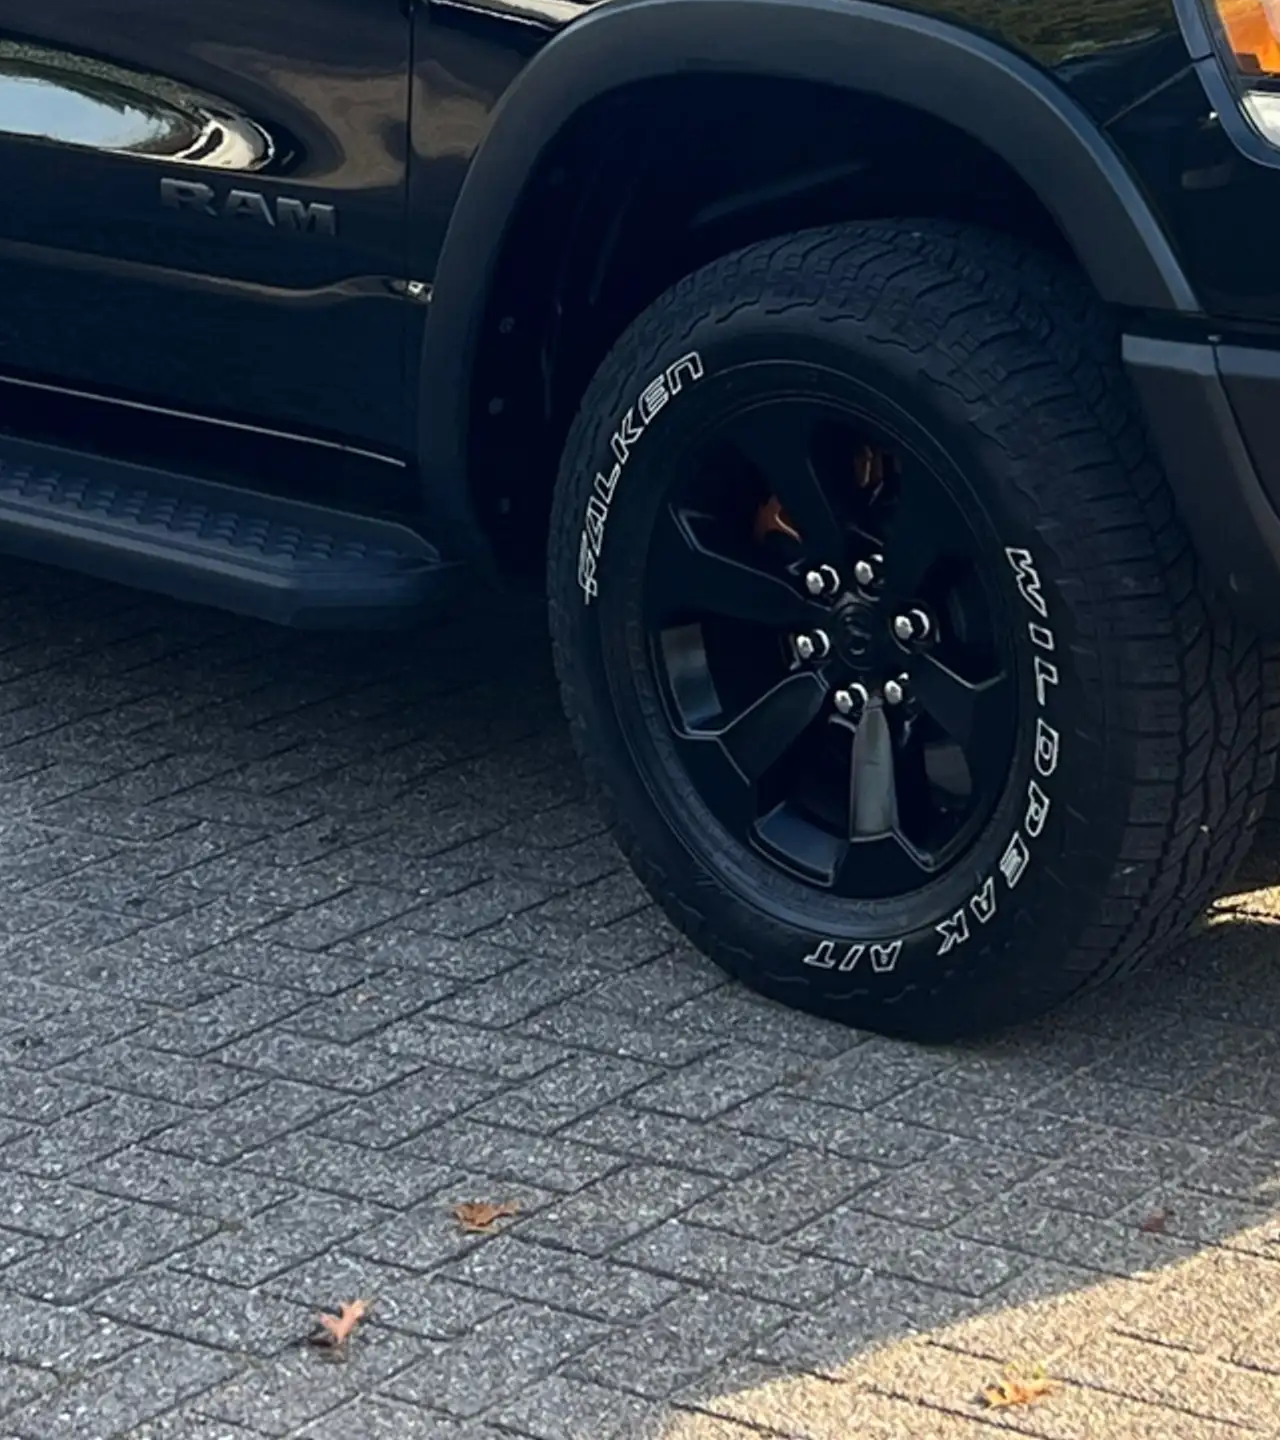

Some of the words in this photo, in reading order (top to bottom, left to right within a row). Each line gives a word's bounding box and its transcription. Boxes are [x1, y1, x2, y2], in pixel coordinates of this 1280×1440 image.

[160, 177, 336, 237] RAM
[578, 351, 704, 605] FALKEN
[936, 547, 1059, 955] WILDPEAK
[803, 939, 903, 973] A/T
